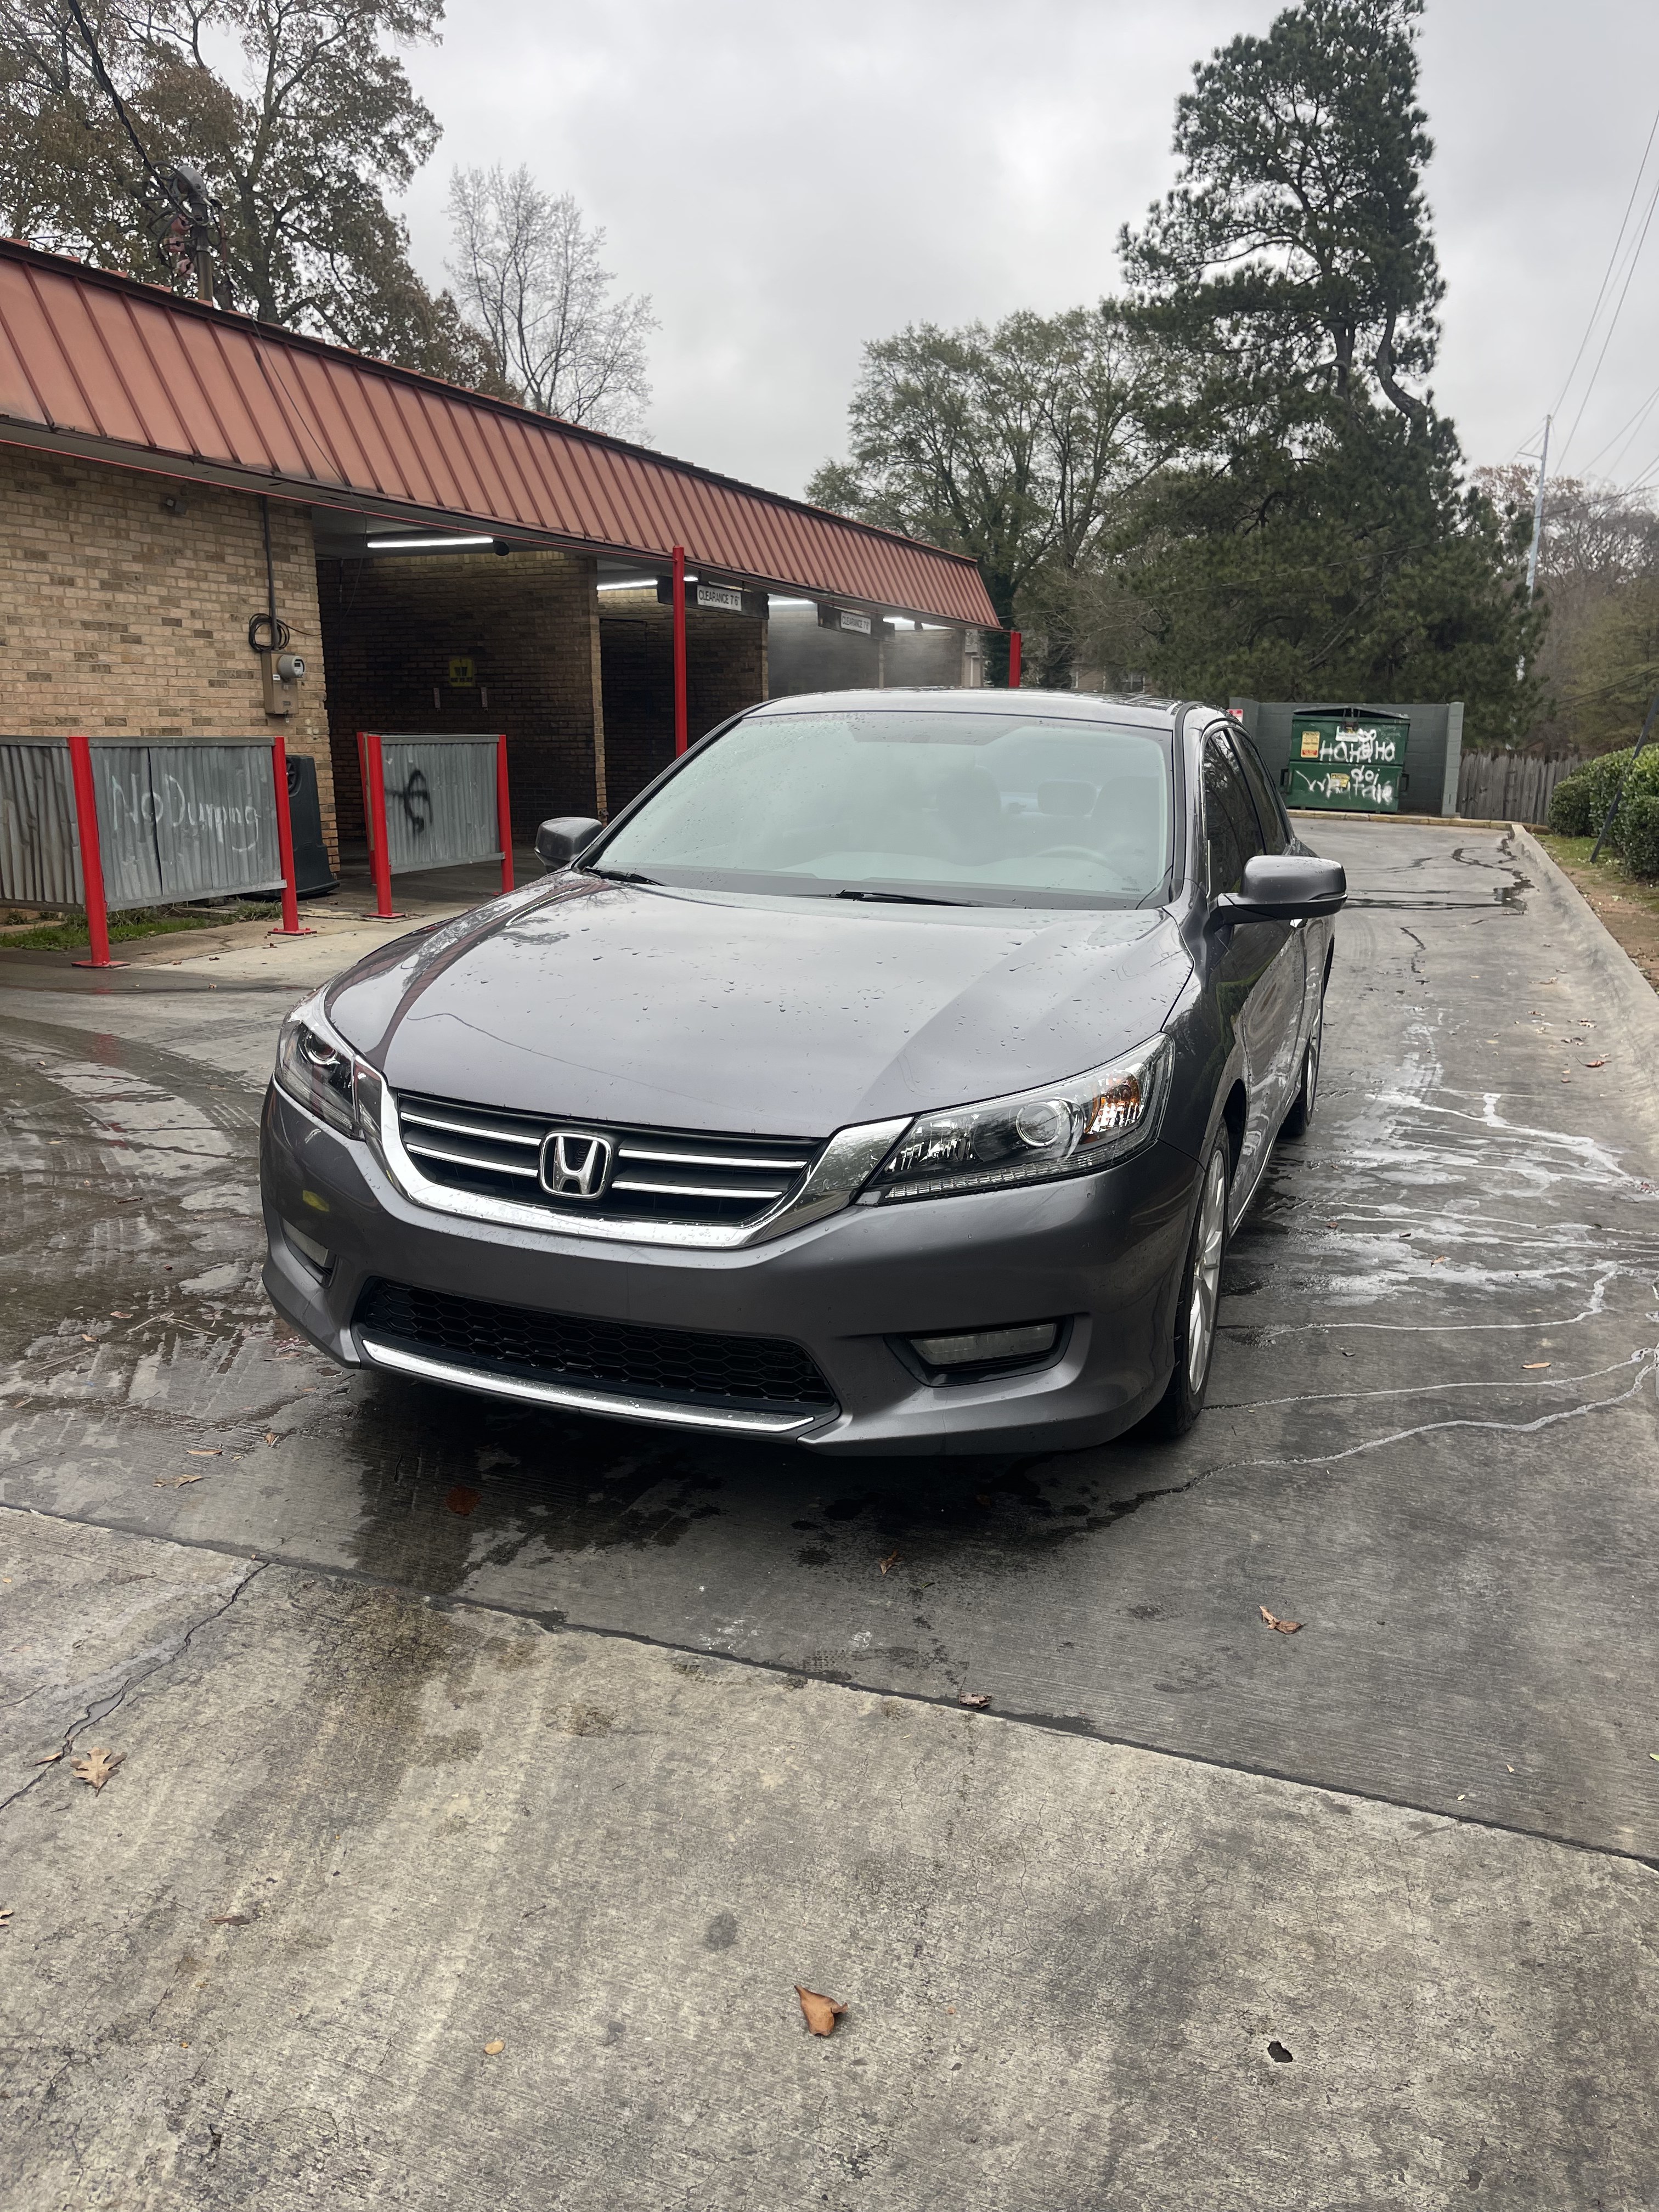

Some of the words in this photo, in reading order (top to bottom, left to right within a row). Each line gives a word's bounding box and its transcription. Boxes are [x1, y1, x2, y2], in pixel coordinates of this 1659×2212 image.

[699, 589, 729, 605] CLEARANCE
[842, 616, 863, 629] CLEARANCE
[111, 773, 163, 830] No
